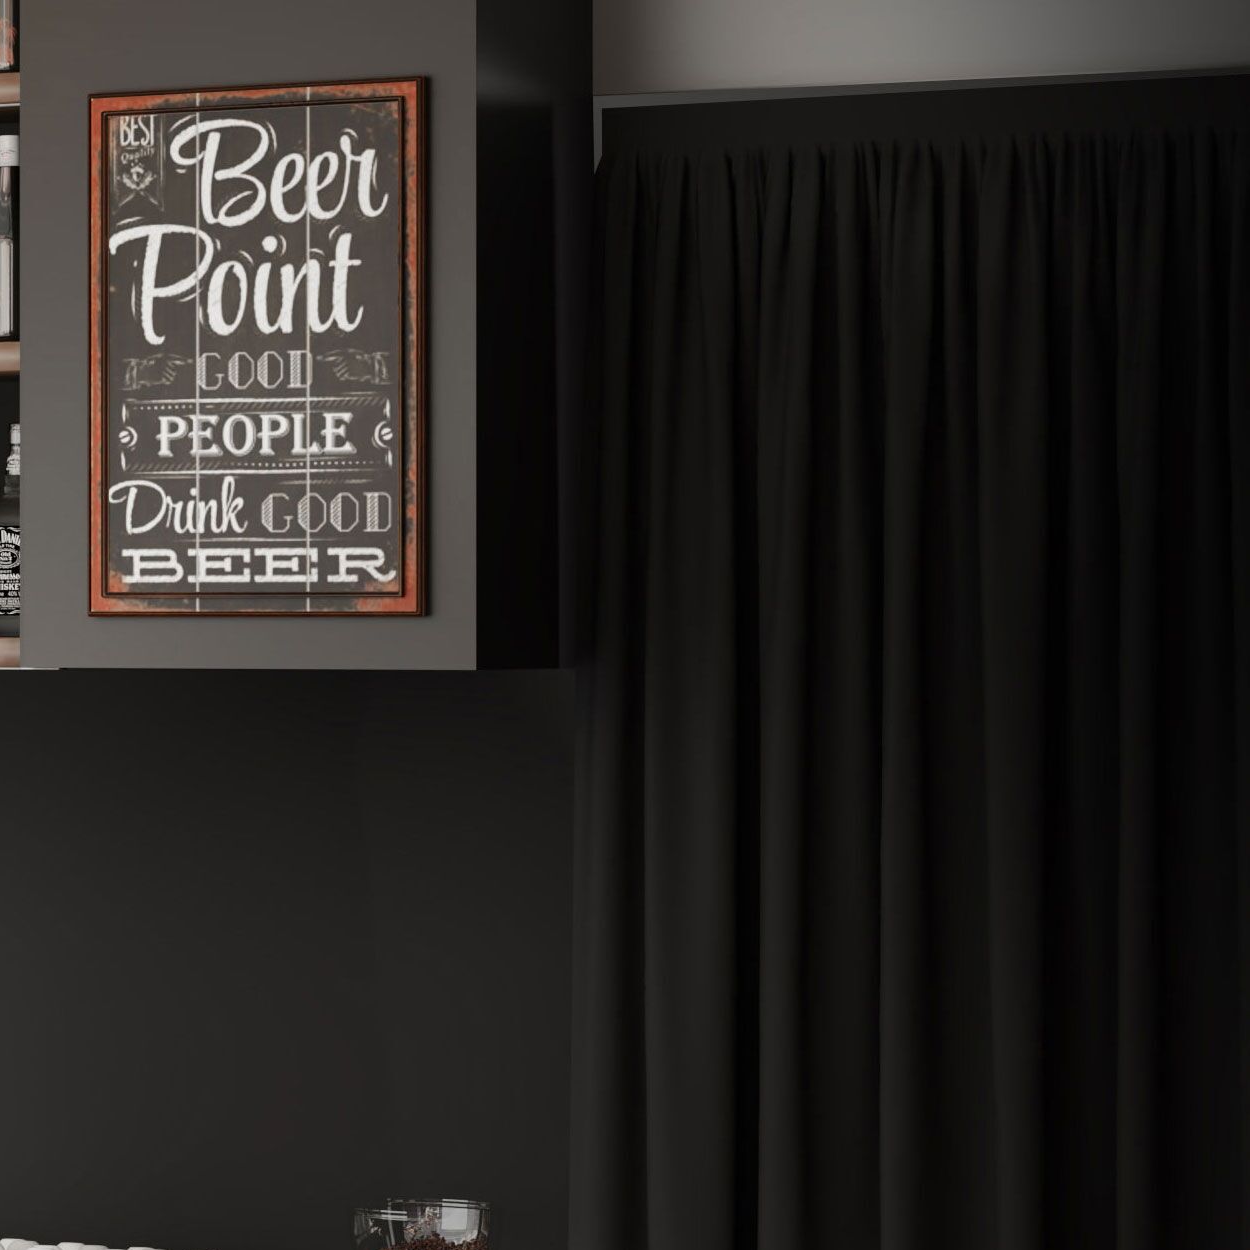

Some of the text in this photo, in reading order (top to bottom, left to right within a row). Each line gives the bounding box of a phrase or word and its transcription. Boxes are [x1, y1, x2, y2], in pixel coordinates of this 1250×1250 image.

[120, 114, 158, 146] BEST
[170, 118, 389, 227] Beer
[108, 224, 364, 346] Point
[198, 350, 314, 390] GOOD
[156, 412, 357, 457] PEOPLE
[108, 476, 392, 536] Drink GOOD
[121, 547, 397, 584] BEER
